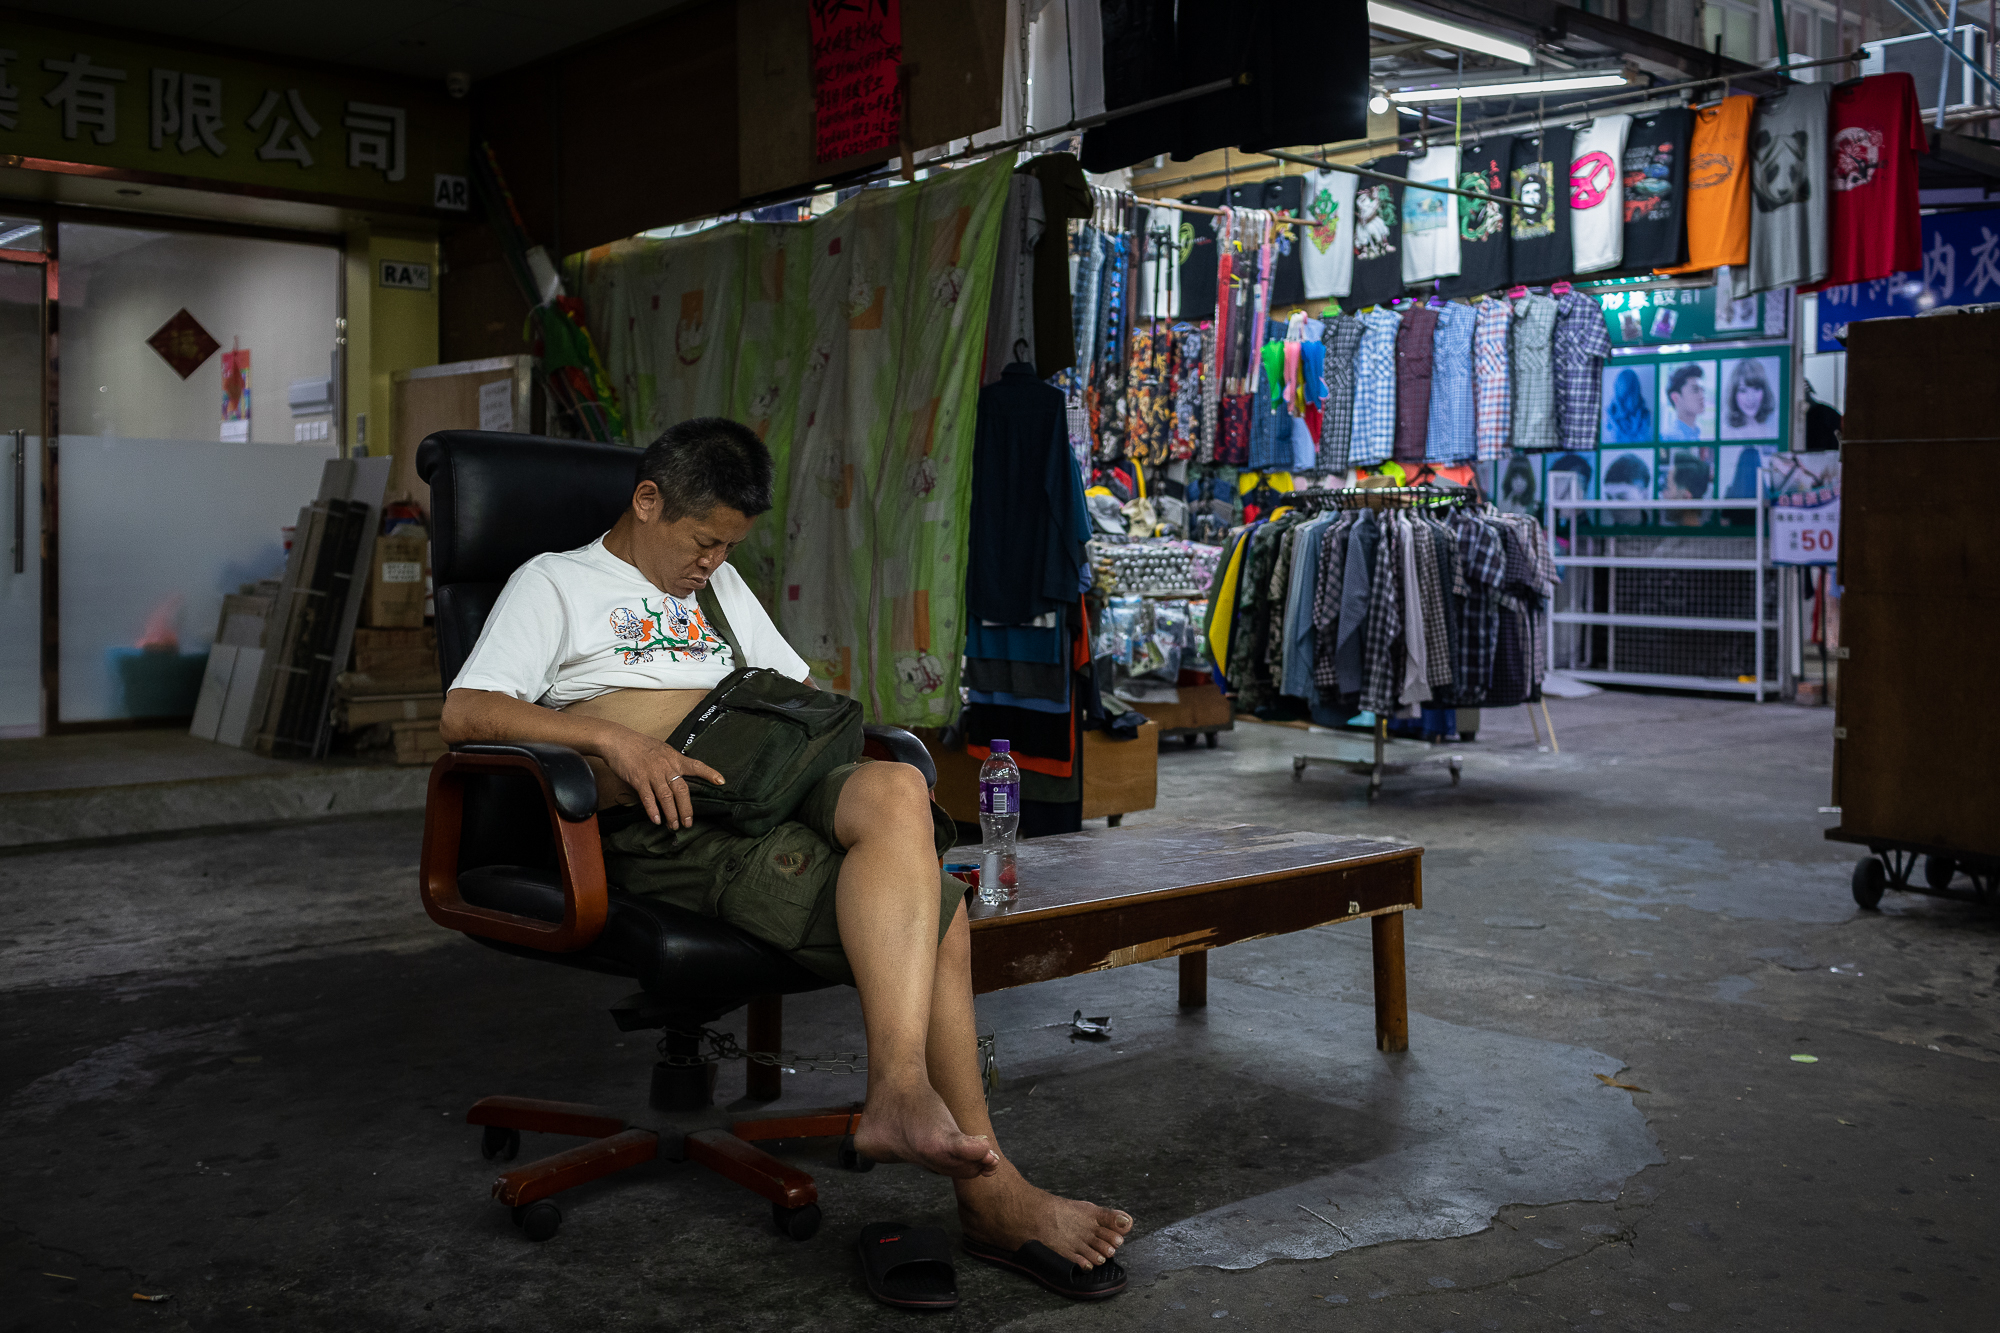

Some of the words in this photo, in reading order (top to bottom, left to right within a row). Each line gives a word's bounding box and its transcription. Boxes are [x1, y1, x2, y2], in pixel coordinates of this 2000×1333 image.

[436, 180, 466, 205] AR
[384, 265, 412, 284] RA
[1801, 529, 1834, 552] 50
[698, 704, 718, 722] TOUGH
